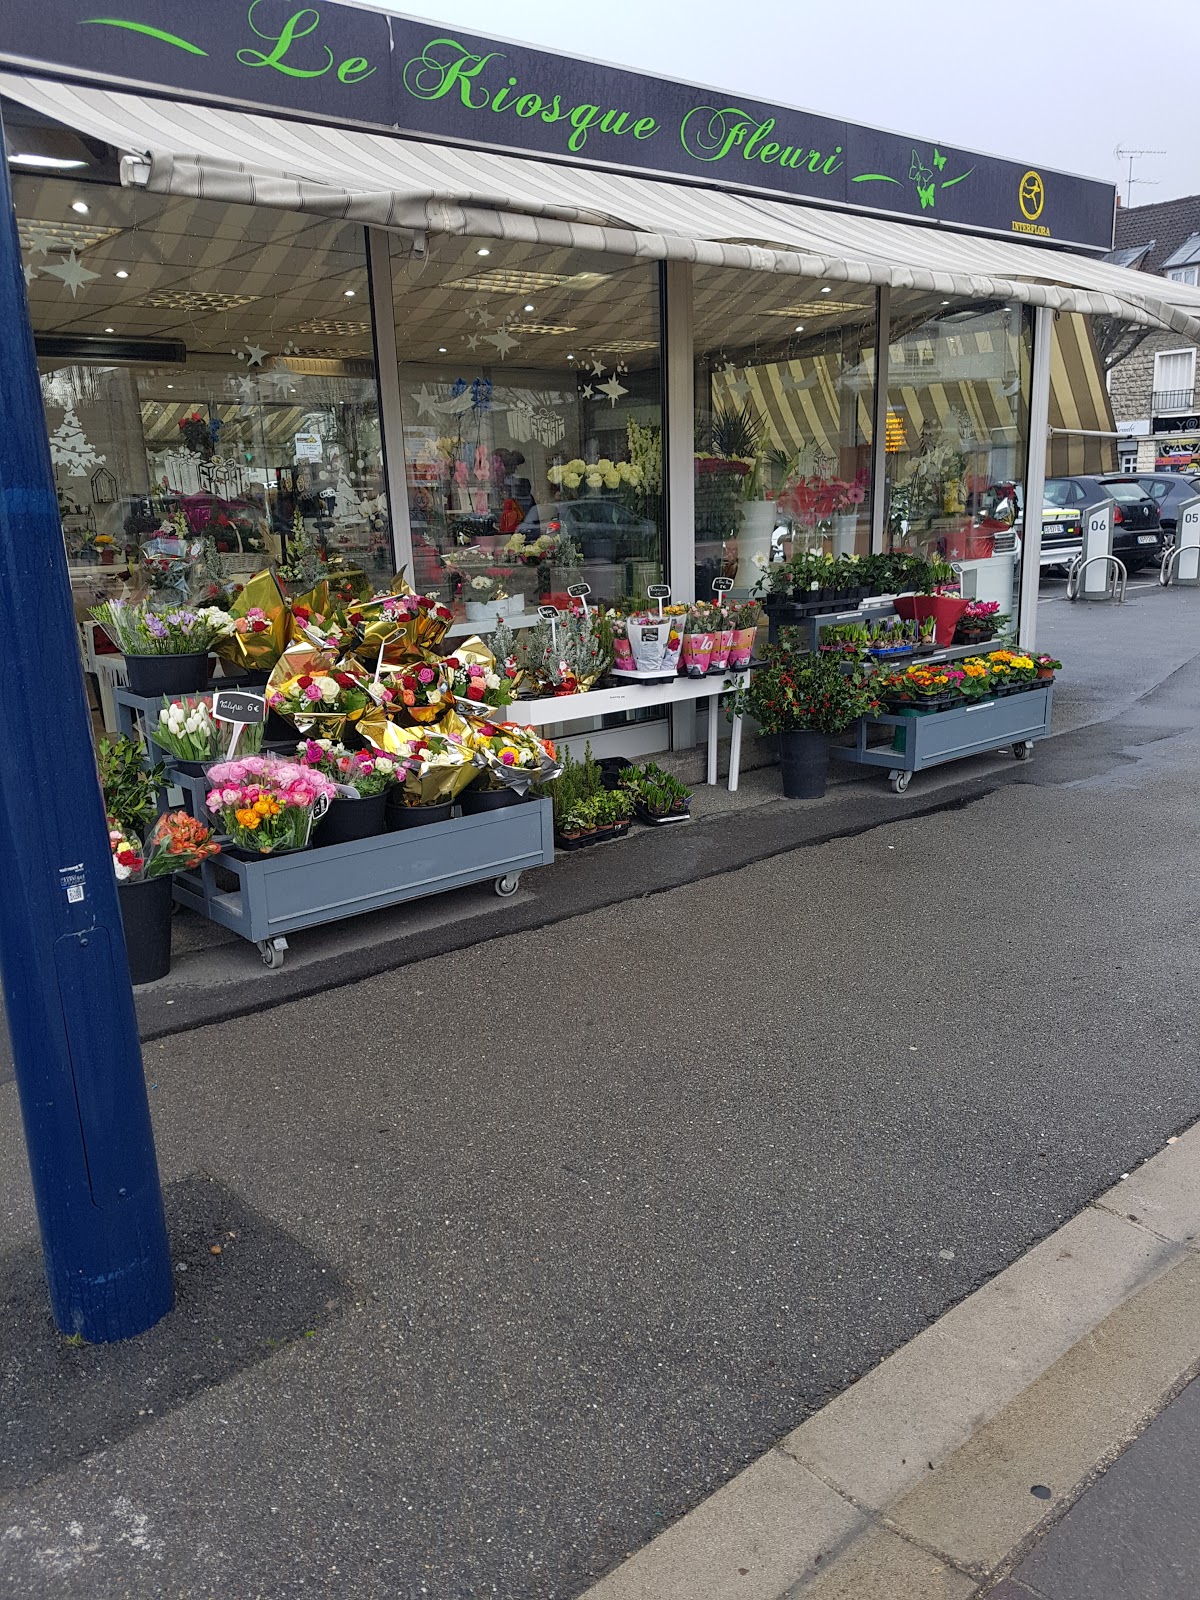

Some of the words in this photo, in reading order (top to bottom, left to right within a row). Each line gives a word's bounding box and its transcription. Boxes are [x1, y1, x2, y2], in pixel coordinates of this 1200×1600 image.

[236, 0, 377, 83] Le
[403, 38, 660, 151] Kiosque
[680, 105, 843, 175] Fleuri
[1011, 220, 1051, 237] INTERFLORA
[1185, 513, 1199, 524] 05
[1091, 520, 1106, 531] 06
[247, 703, 260, 713] 6€
